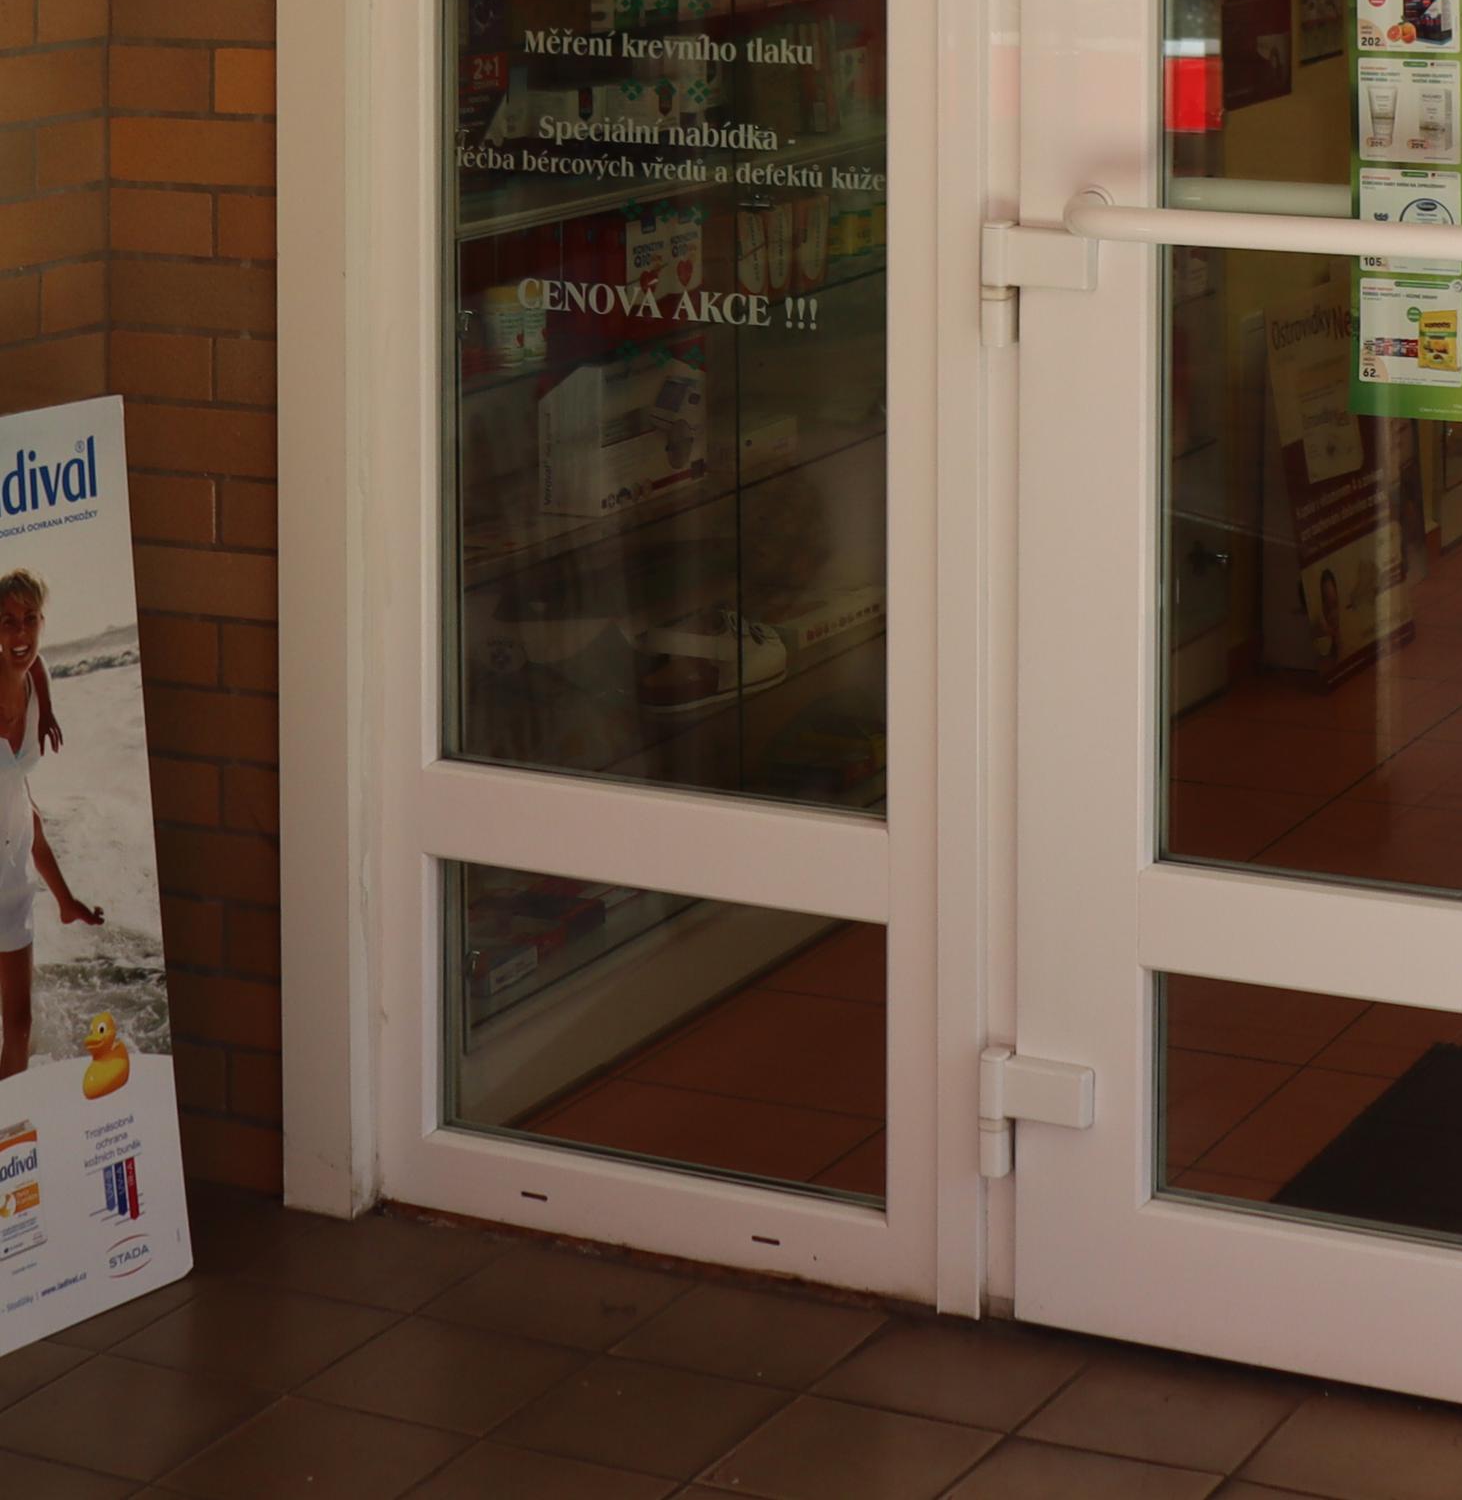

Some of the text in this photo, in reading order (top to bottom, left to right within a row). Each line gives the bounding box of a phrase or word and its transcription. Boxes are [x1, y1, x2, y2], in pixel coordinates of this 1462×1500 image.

[524, 27, 814, 65] Měření krevního tlaku
[1361, 37, 1381, 46] 202
[539, 114, 659, 147] Speciální
[669, 120, 778, 151] nabídka
[456, 145, 886, 192] léčba bércových vředů a defektů kůže
[1364, 256, 1382, 266] 105
[517, 277, 818, 330] CENOVÁ AKCE !!!
[1363, 368, 1376, 378] 62
[0, 435, 97, 517] dival
[95, 1132, 129, 1150] ochrana
[109, 1244, 149, 1269] STADA
